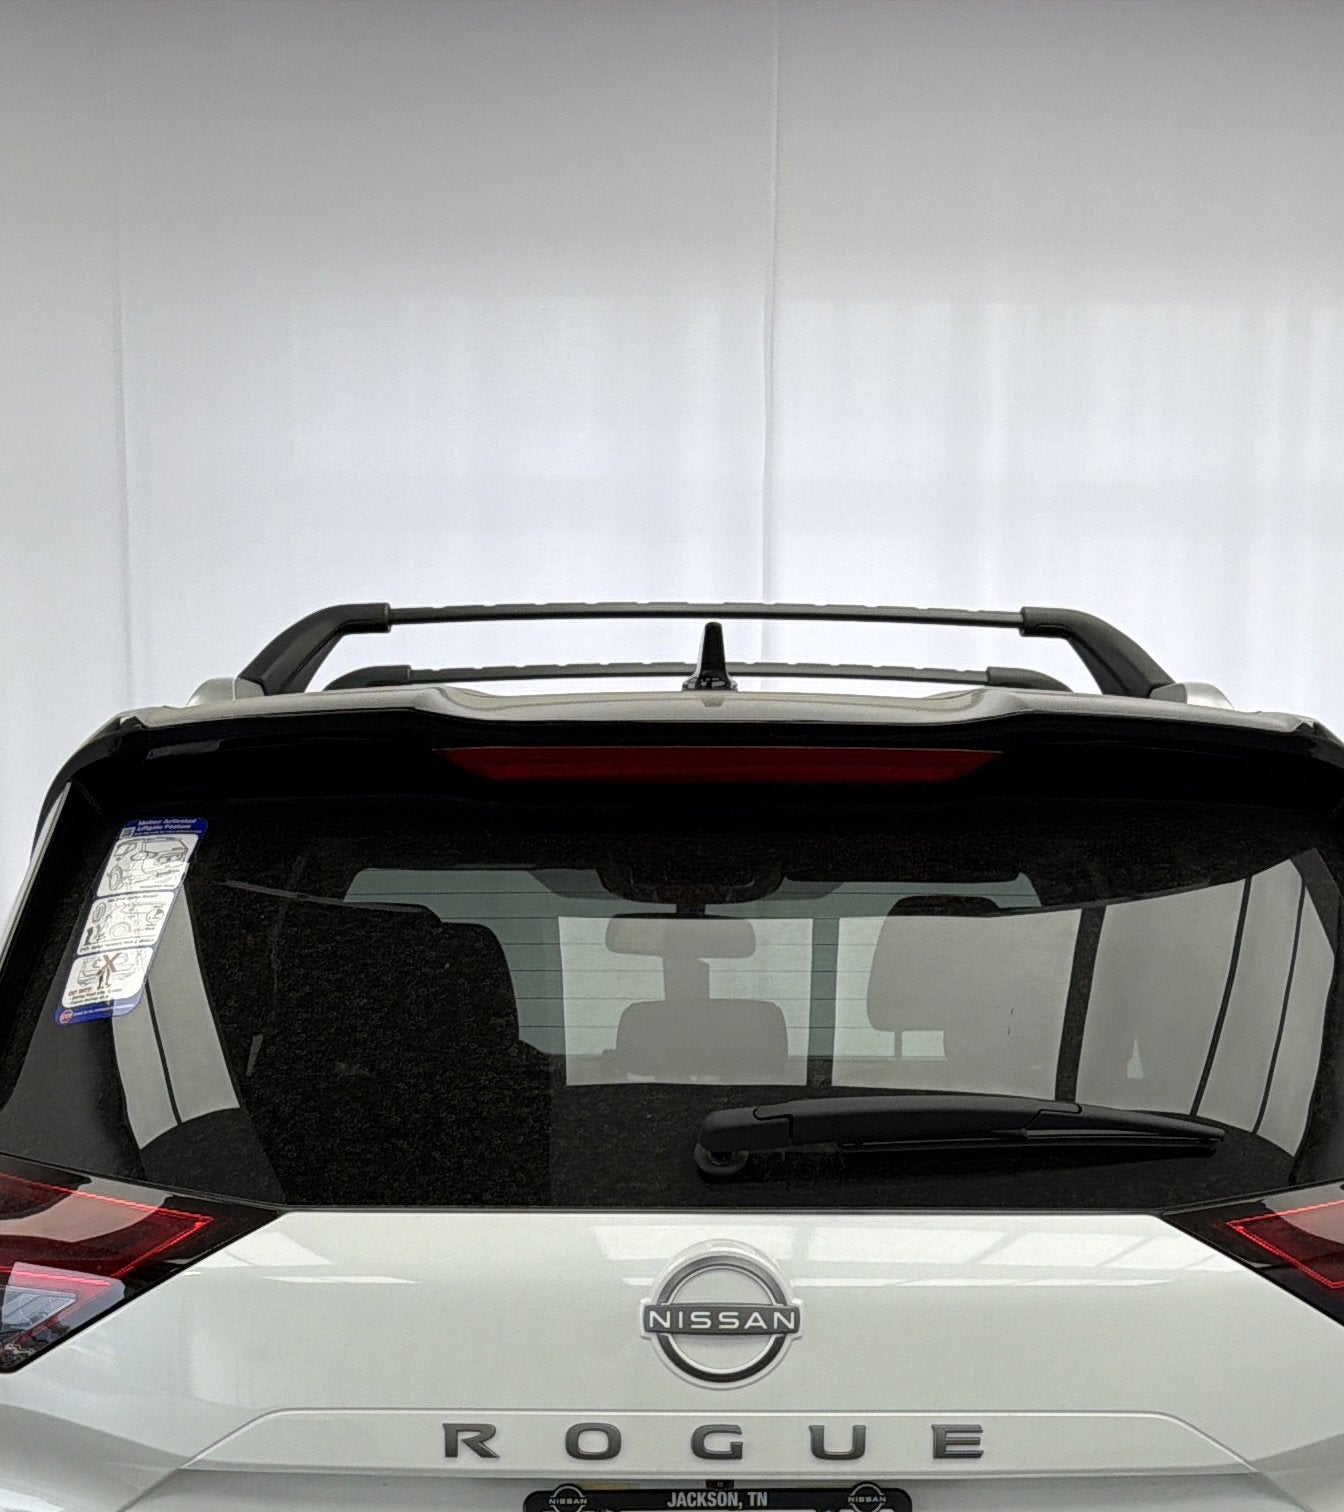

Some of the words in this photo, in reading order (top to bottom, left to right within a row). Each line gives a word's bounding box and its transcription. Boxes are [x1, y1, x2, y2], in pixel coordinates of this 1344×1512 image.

[649, 1310, 795, 1330] NISSAN
[442, 1422, 984, 1461] ROGUE
[666, 1491, 743, 1509] JACKSON,
[748, 1491, 768, 1506] TN
